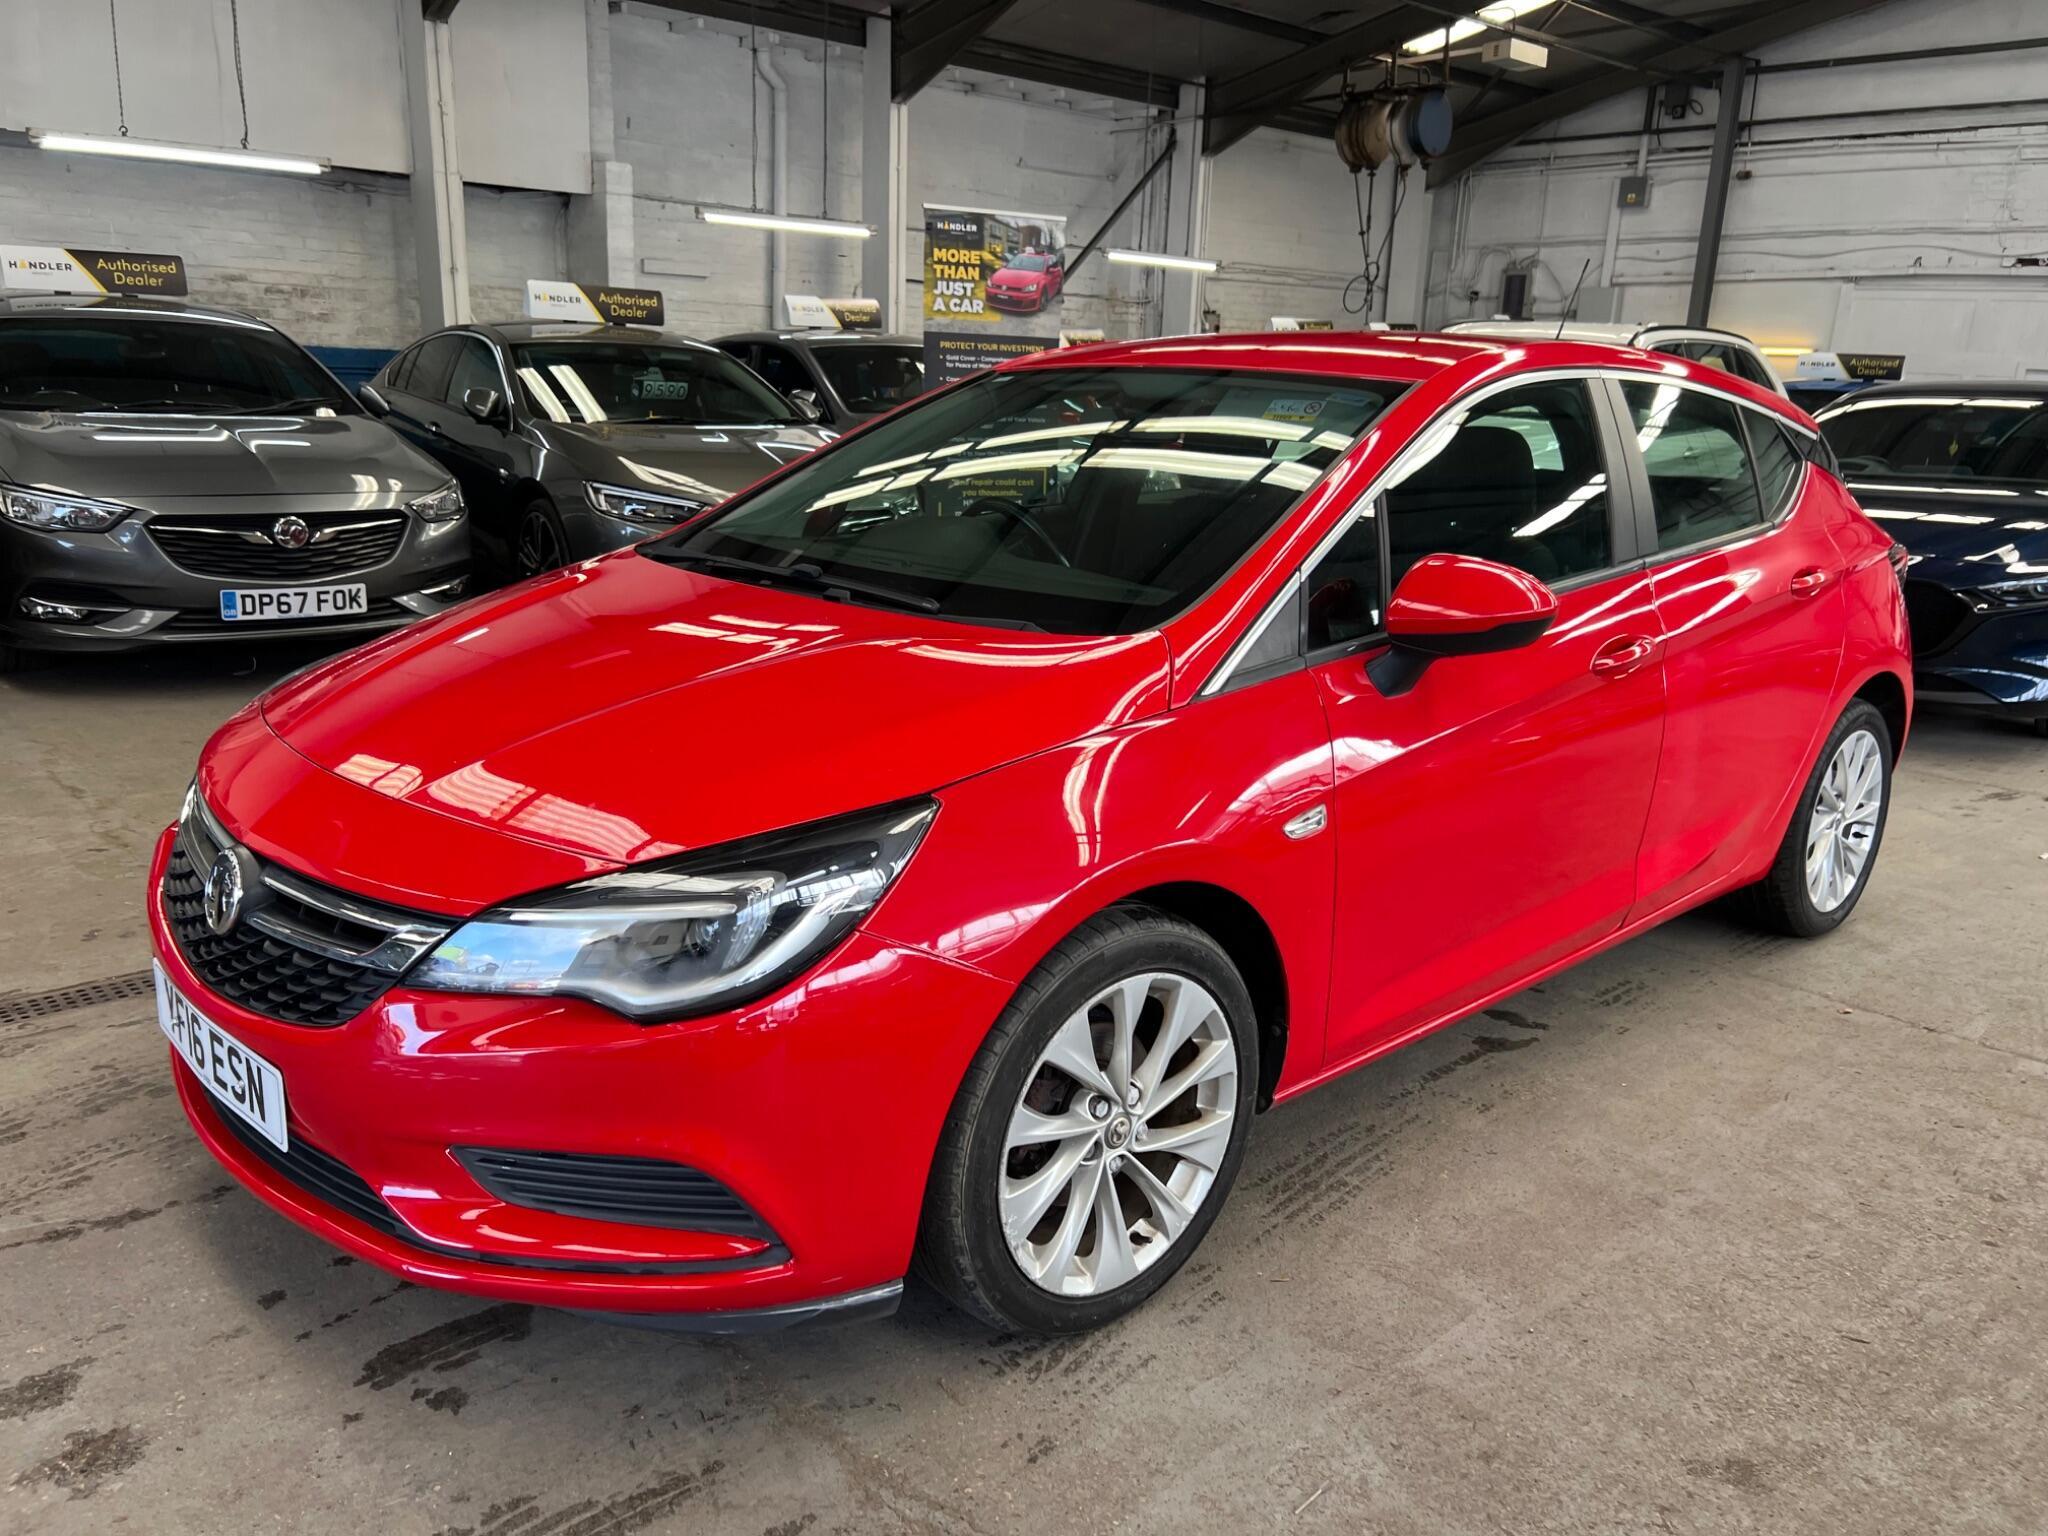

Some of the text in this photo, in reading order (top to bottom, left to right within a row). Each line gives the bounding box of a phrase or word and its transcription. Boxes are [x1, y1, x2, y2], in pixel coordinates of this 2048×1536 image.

[933, 248, 981, 264] MORE
[97, 258, 177, 274] Authorised
[933, 264, 980, 281] THAN
[114, 272, 164, 287] Dealer
[933, 281, 974, 297] JUST
[599, 292, 658, 307] Authorised
[933, 297, 984, 314] A CAR
[611, 305, 648, 319] Dealer
[844, 312, 871, 322] Dealer
[940, 341, 1045, 354] PROTECT YOUR INVESTMENT
[1850, 358, 1900, 368] Authorised
[1857, 367, 1887, 376] Dealer
[644, 383, 687, 399] 9590
[240, 588, 363, 617] DP67 FOK
[164, 978, 266, 1124] YF16 ESN
